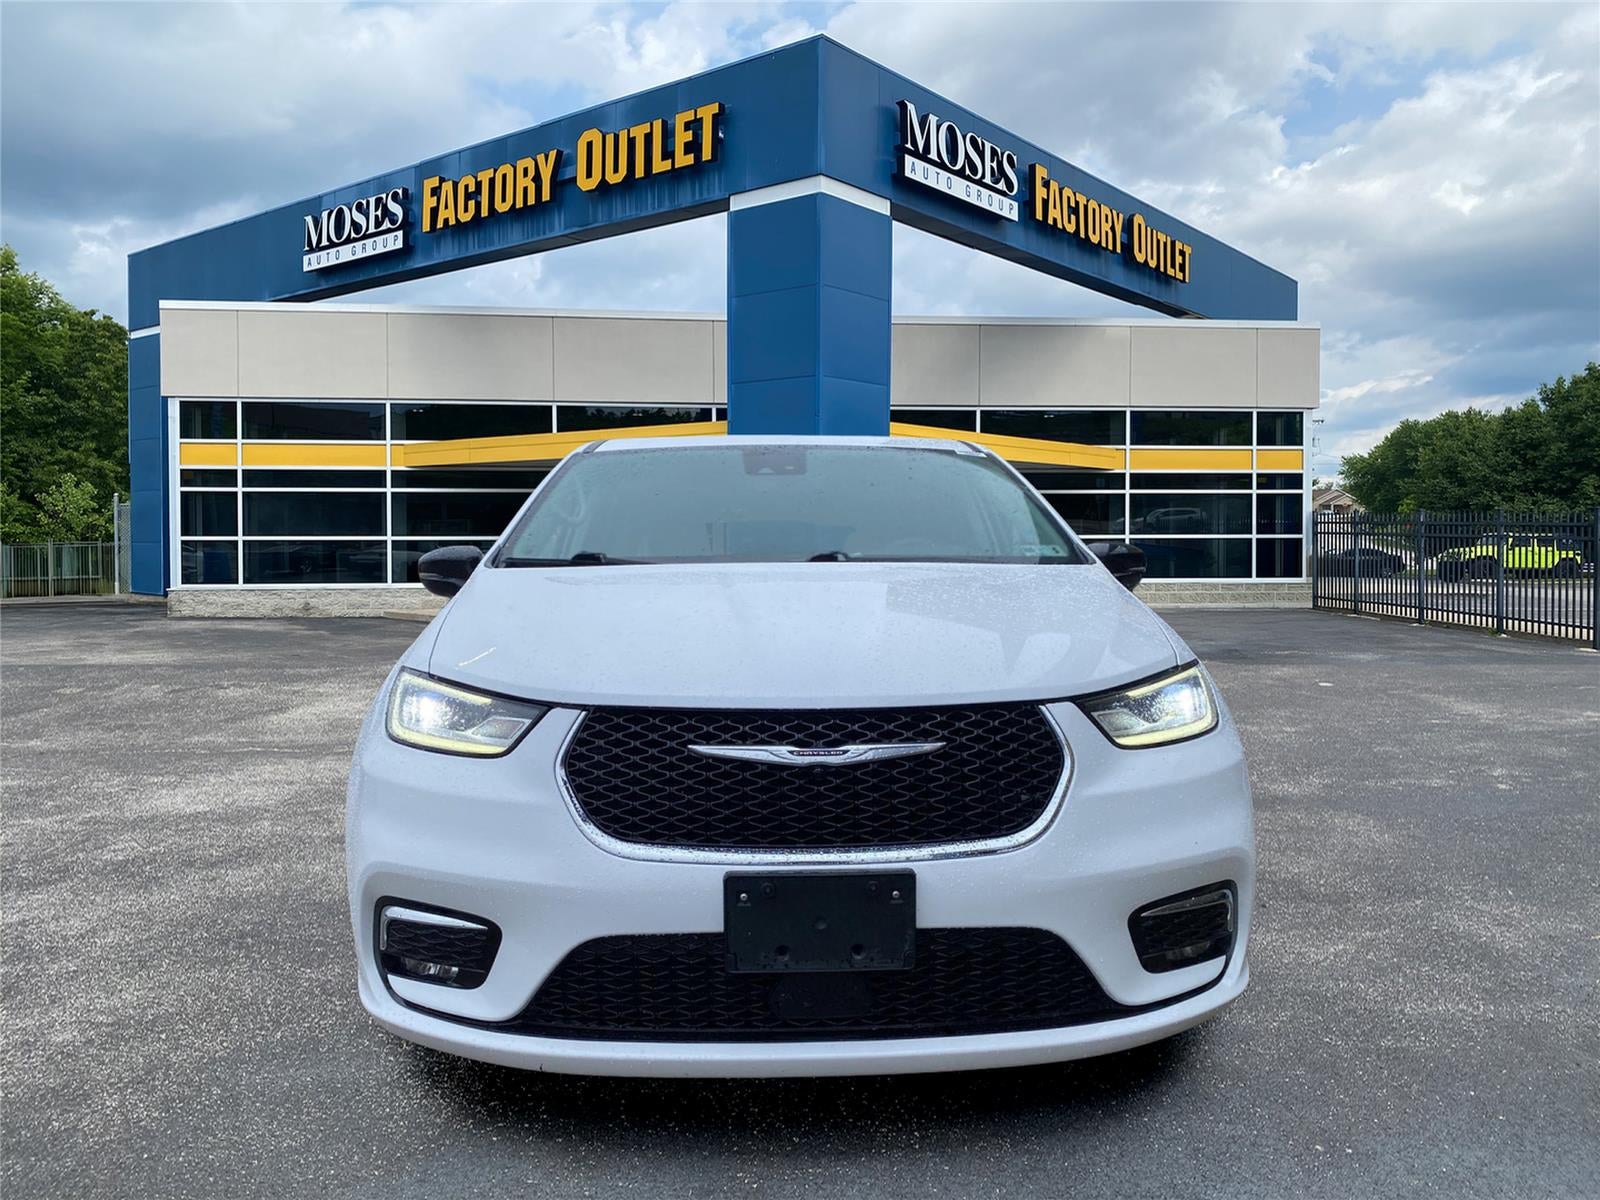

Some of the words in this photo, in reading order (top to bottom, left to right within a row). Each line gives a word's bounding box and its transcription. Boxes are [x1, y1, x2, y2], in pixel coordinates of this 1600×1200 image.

[422, 149, 559, 233] FACTORY
[576, 102, 720, 192] OUTLET
[904, 100, 1018, 196] MOSES
[303, 188, 404, 251] MOSES
[910, 161, 953, 190] AUTO
[965, 185, 1014, 215] GROUP
[1034, 163, 1124, 253] FACTORY
[1132, 213, 1192, 283] OUTLET
[307, 251, 341, 267] AUTO
[351, 235, 400, 256] GROUP
